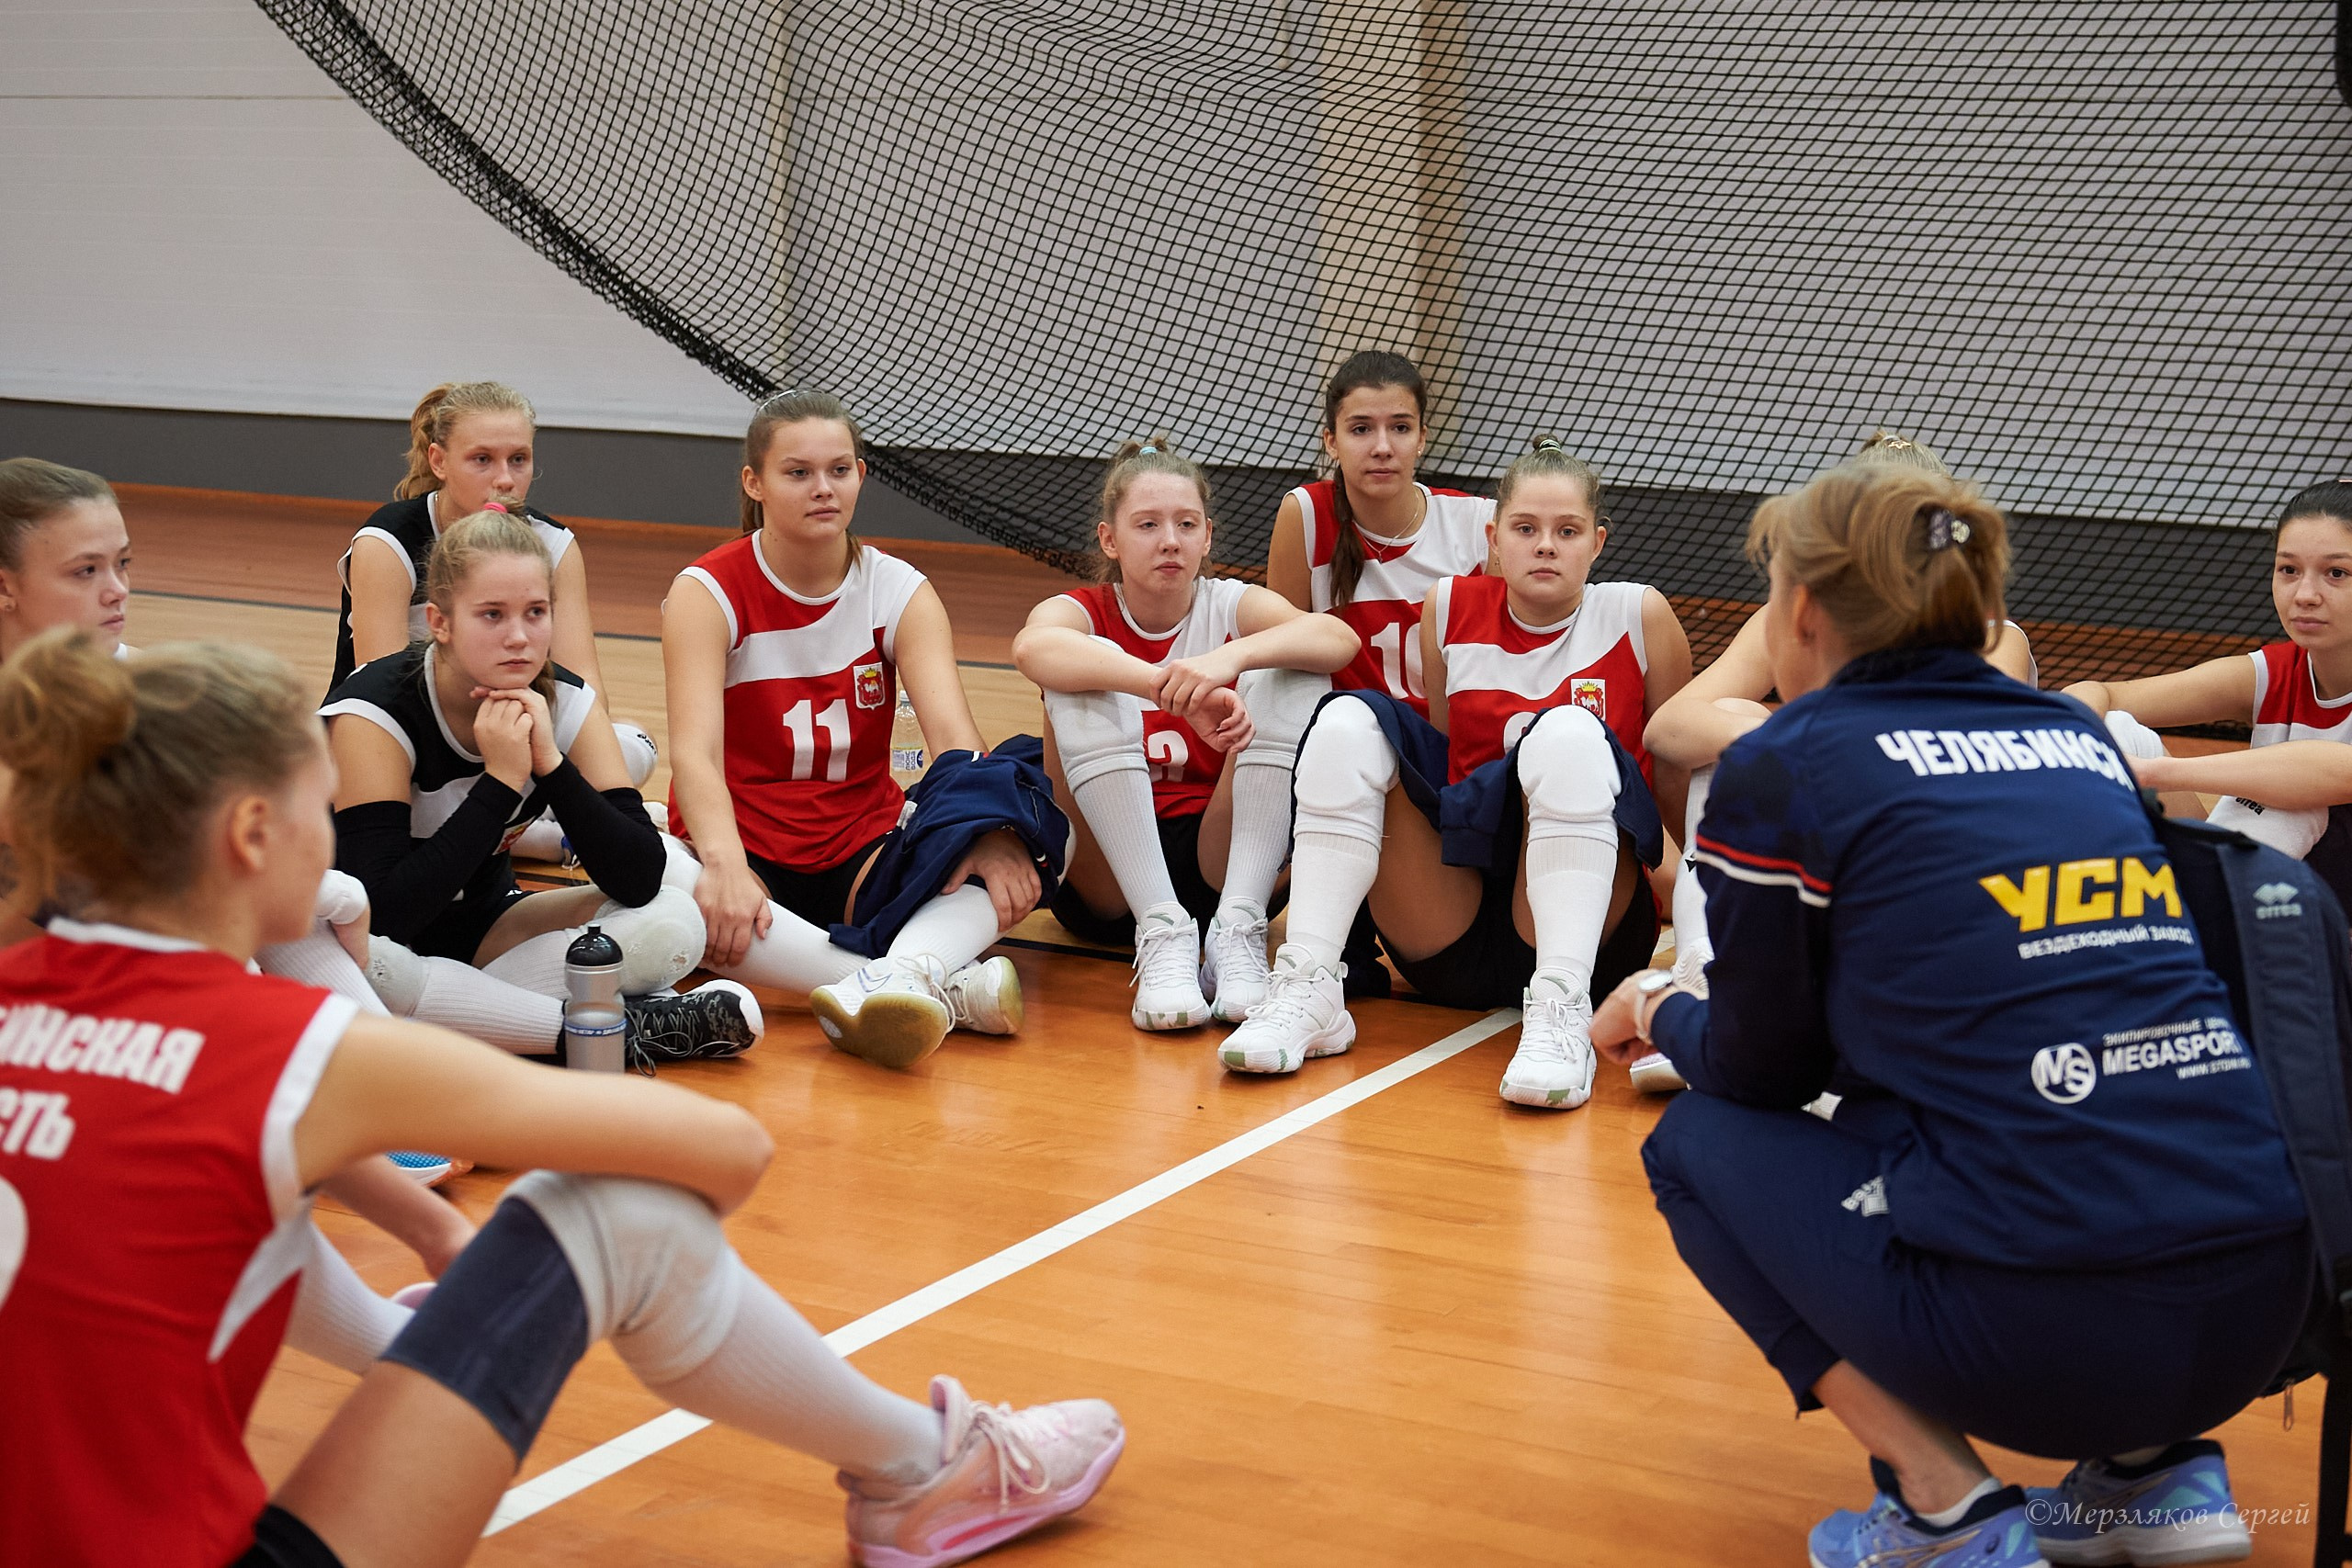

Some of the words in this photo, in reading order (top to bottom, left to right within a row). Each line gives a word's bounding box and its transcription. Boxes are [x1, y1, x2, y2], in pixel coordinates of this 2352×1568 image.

[783, 699, 851, 782] 11
[1978, 857, 2183, 932] УСМ
[2018, 923, 2150, 959] ВЕЗДЕХОДНЫЙ
[0, 1003, 206, 1095] ИНСКАЯ
[2102, 1031, 2243, 1077] MEGASPOR
